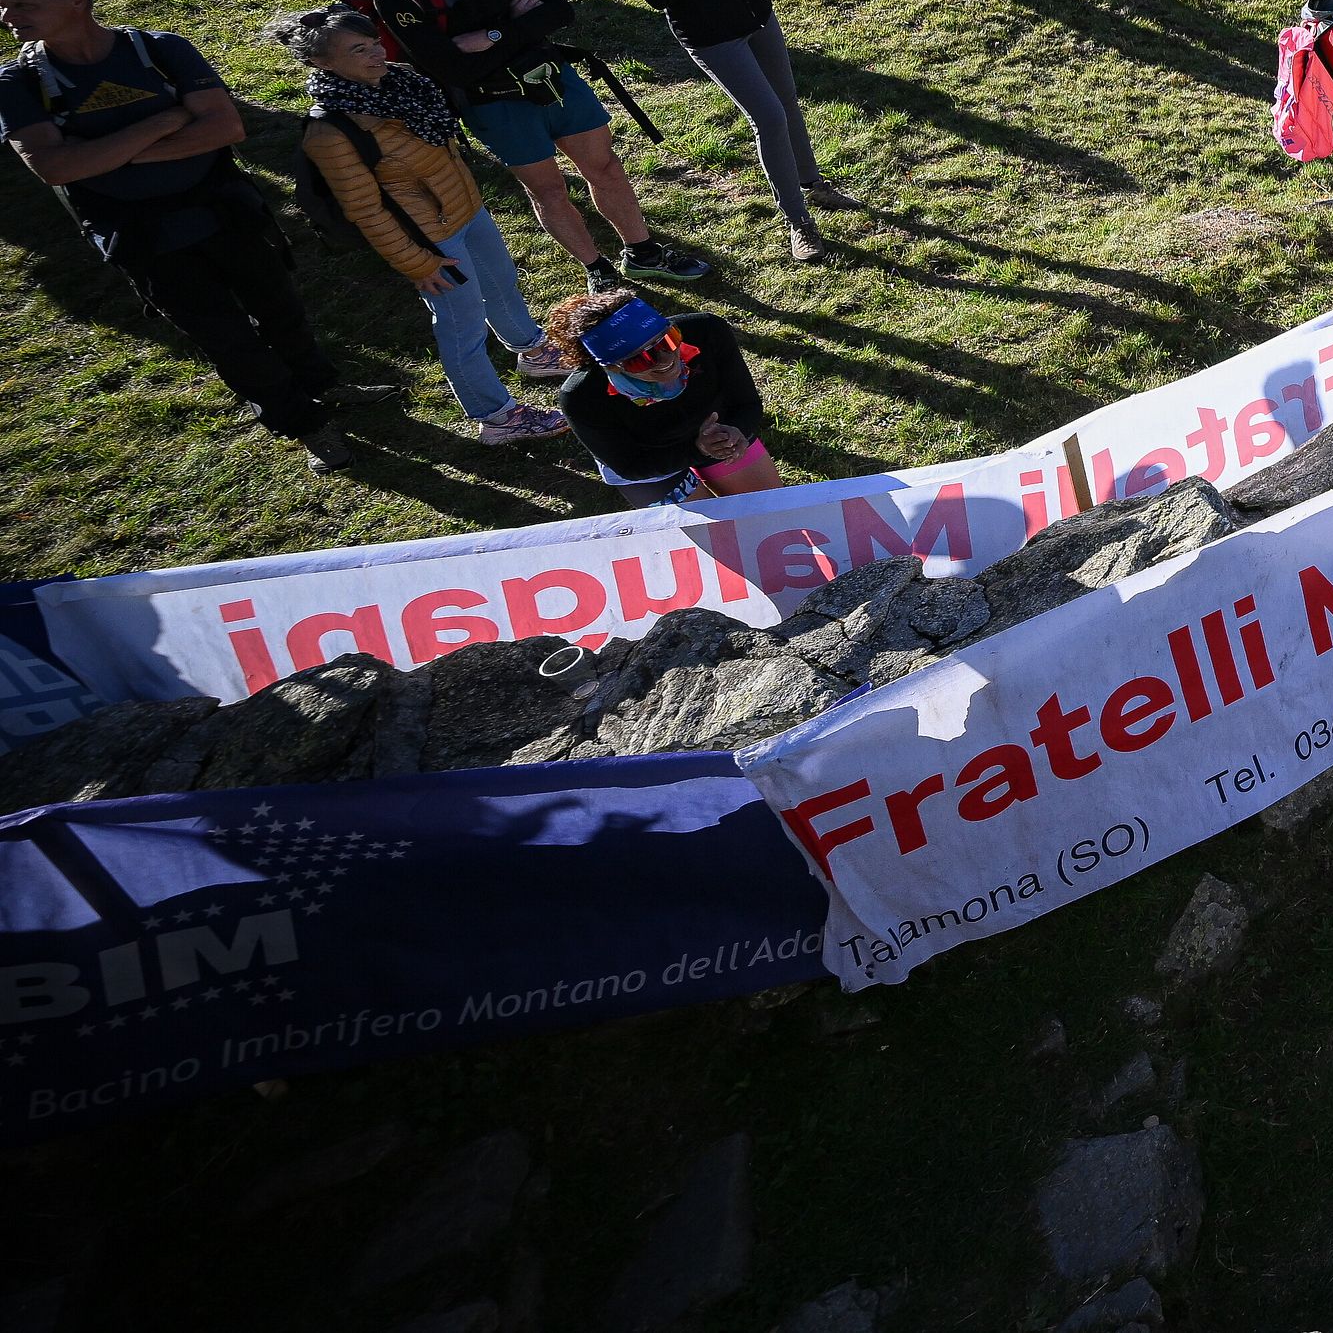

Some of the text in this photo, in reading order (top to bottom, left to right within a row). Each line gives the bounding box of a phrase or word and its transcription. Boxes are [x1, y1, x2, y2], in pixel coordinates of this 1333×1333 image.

[781, 595, 1275, 884] Fratelli
[1205, 755, 1275, 809] Tel.
[0, 909, 299, 1026] BIM
[838, 816, 1150, 968] Talamona (SO)
[27, 925, 825, 1121] Bacino Imbrifero Montano dell'Add
